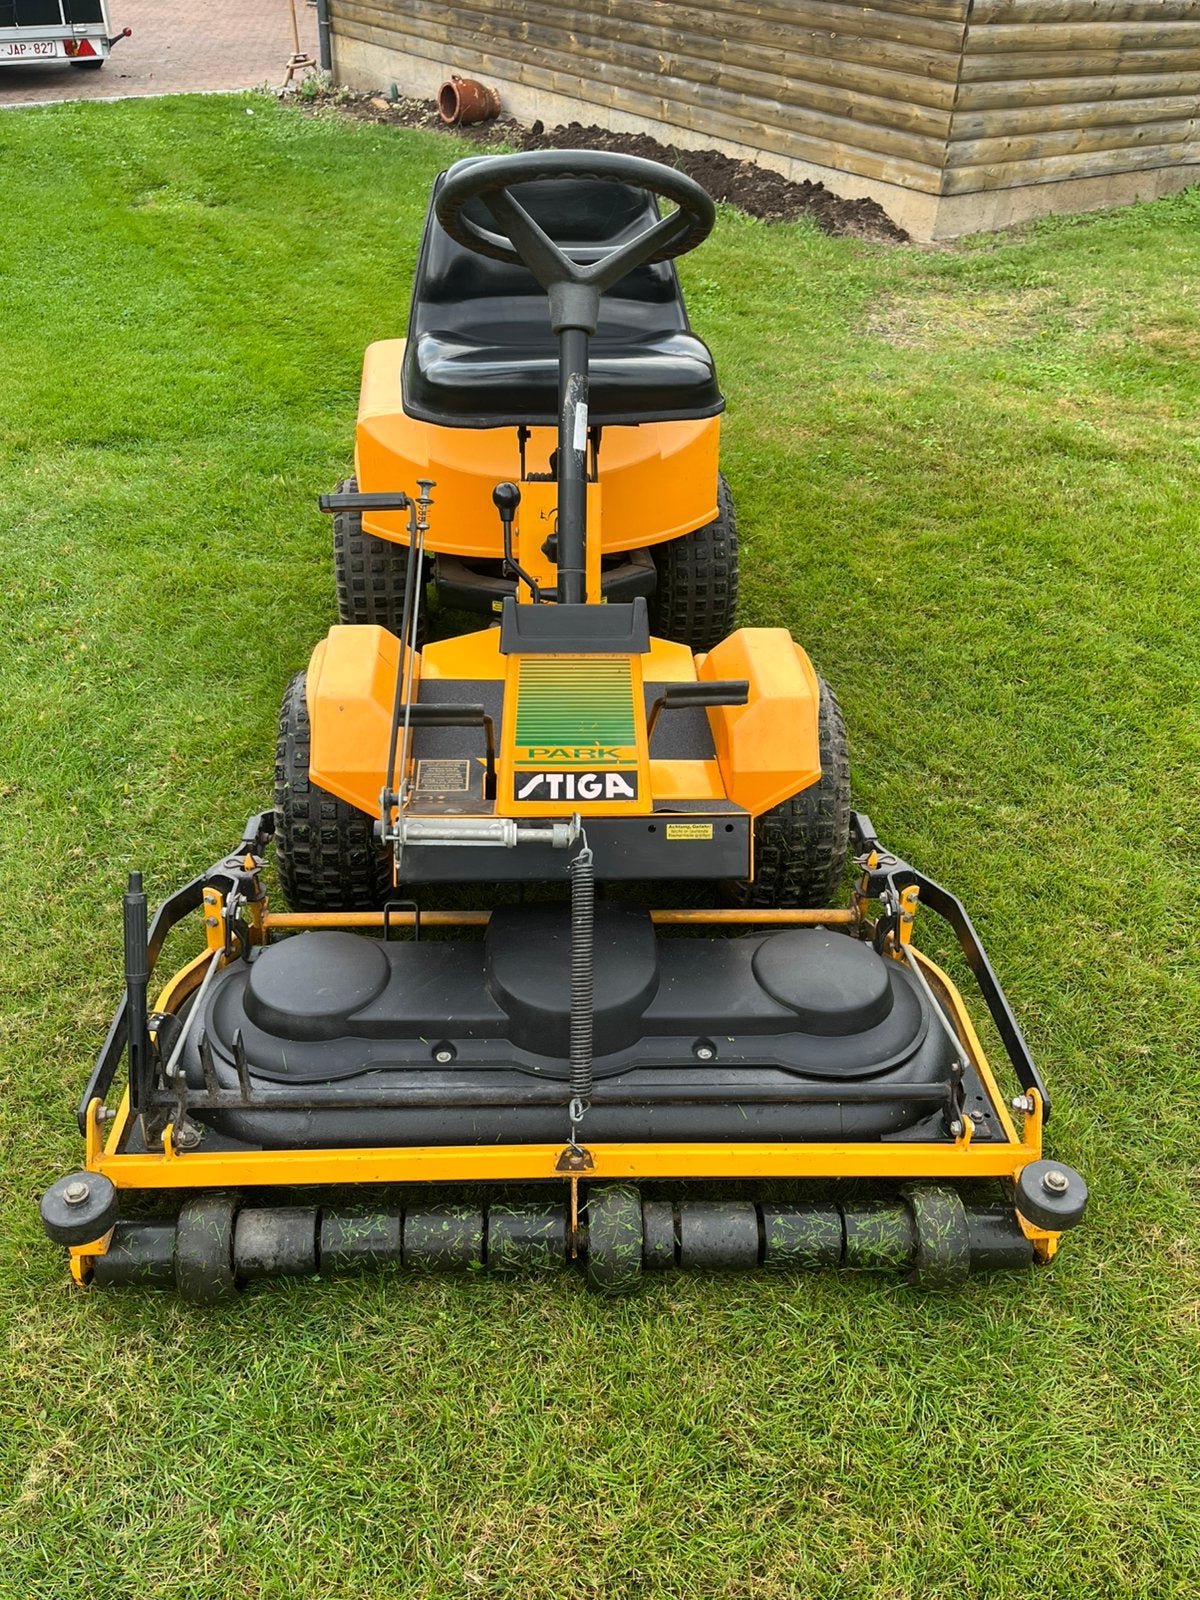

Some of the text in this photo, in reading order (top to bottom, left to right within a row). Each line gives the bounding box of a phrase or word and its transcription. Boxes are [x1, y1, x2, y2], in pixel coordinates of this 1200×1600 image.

[33, 42, 53, 54] 827
[528, 748, 620, 758] PARK
[518, 773, 634, 799] STIGA
